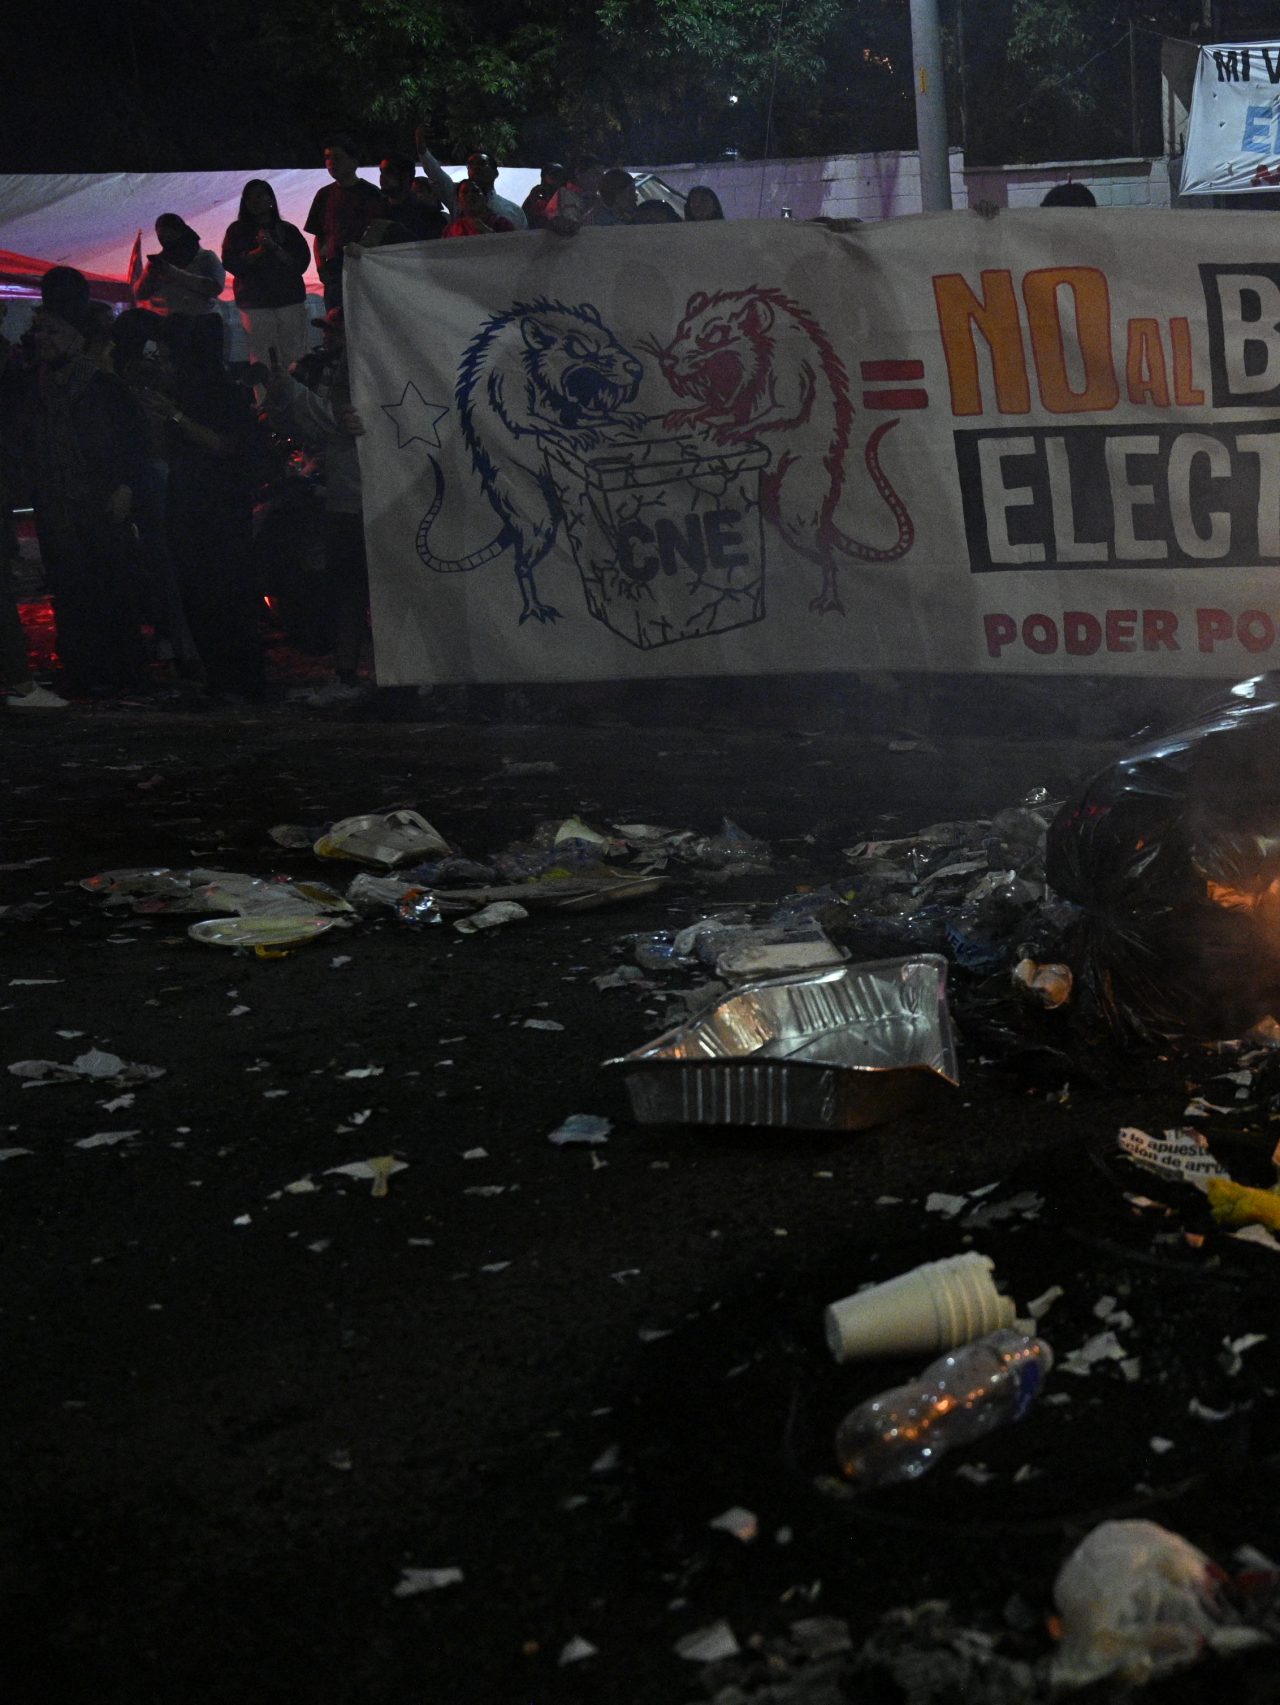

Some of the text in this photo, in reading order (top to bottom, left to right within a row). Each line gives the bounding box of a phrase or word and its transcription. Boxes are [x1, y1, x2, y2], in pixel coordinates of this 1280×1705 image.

[1213, 49, 1250, 82] MI
[932, 266, 1120, 416] NO
[1126, 316, 1205, 407] AL
[616, 509, 749, 582] CNE
[984, 609, 1182, 658] PODER
[1147, 1140, 1210, 1157] apuest
[1162, 1154, 1182, 1168] de
